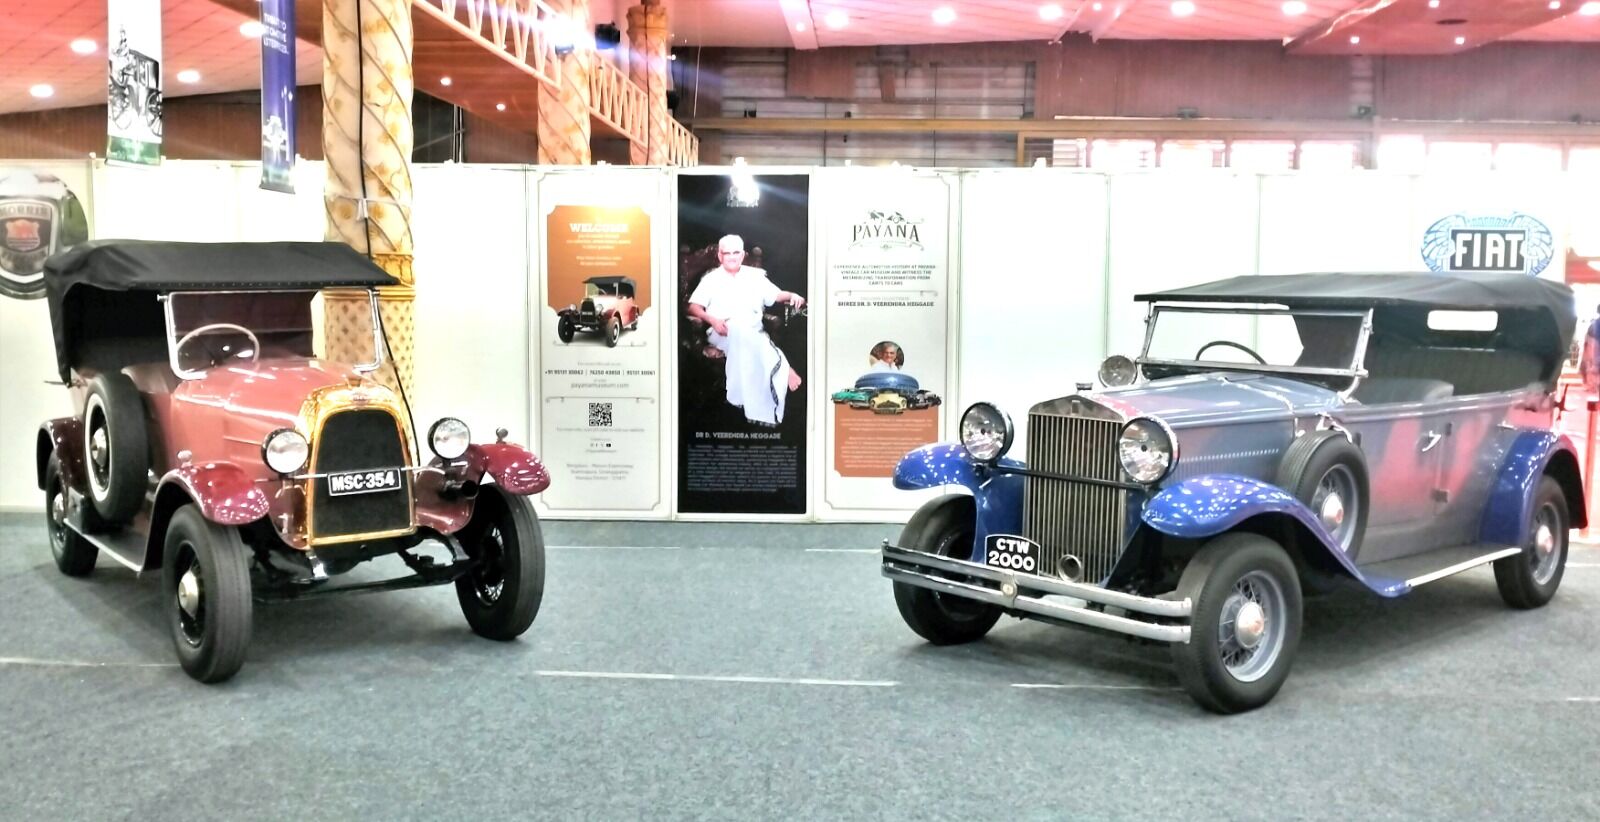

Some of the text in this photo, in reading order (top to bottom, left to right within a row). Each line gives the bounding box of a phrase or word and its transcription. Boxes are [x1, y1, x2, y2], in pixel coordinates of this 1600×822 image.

[569, 222, 629, 232] WELCOME
[853, 224, 920, 242] PAYANA
[1455, 232, 1524, 268] FIAT
[996, 538, 1030, 554] CTW
[988, 550, 1035, 572] 2000
